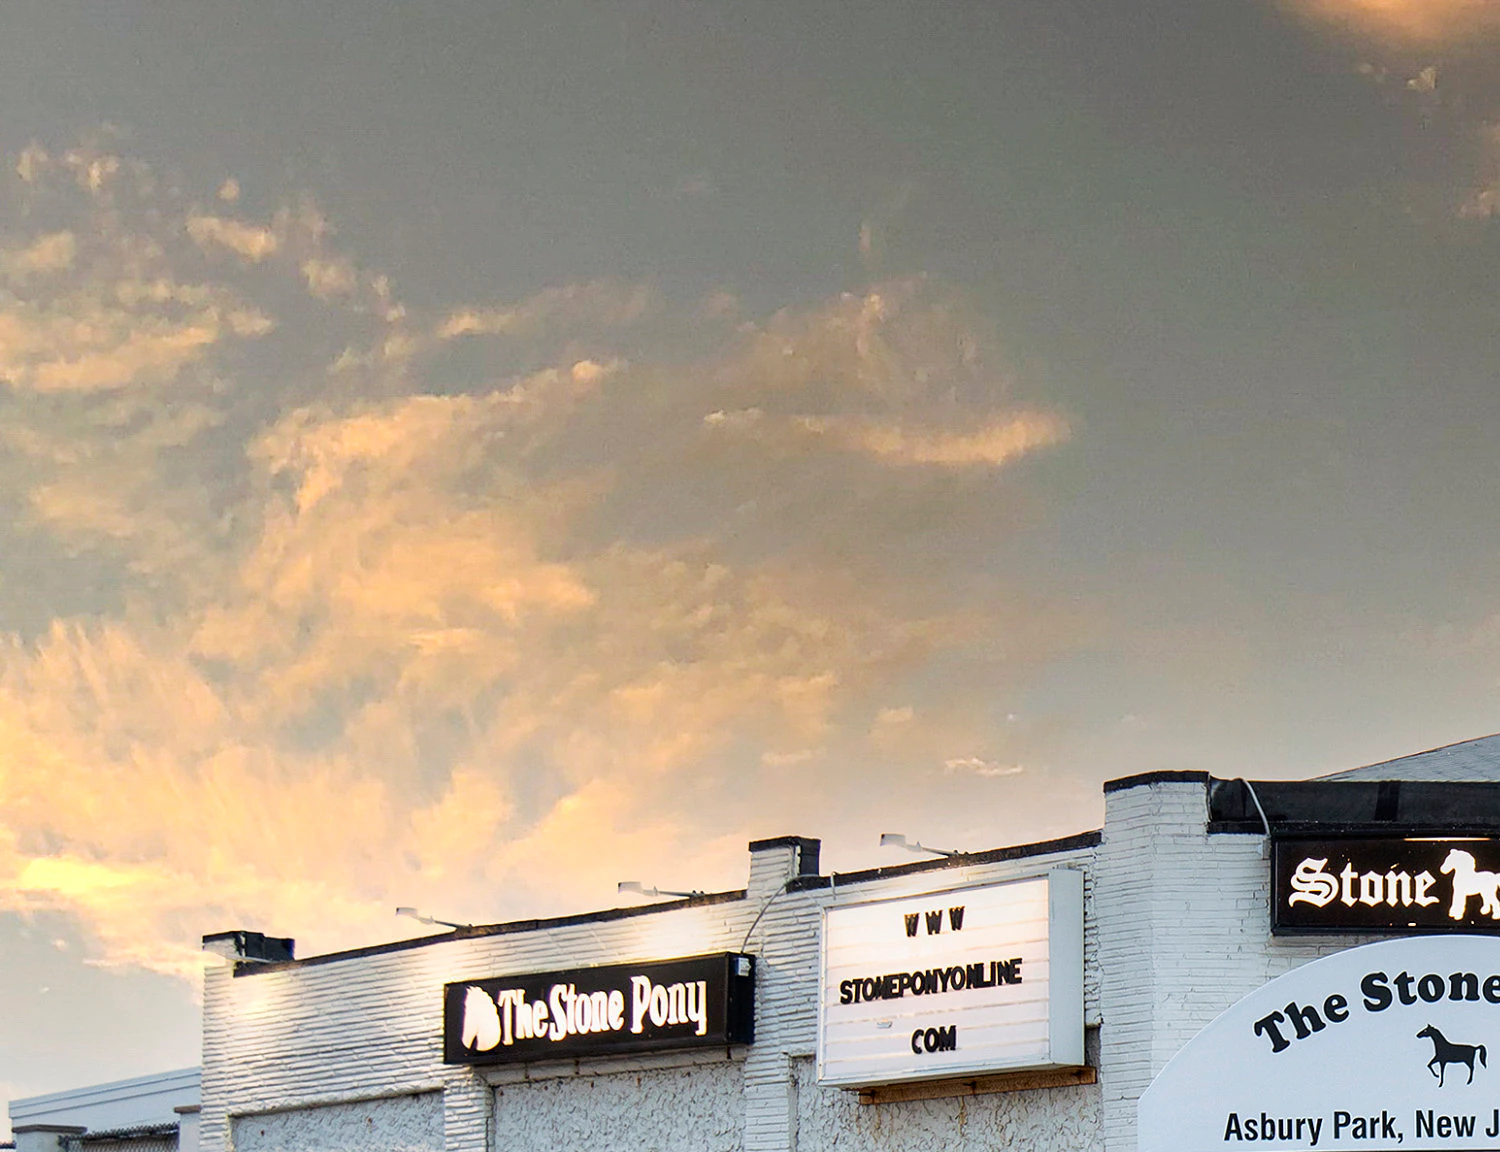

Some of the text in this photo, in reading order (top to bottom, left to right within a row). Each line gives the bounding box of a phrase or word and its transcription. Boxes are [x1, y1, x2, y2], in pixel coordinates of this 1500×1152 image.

[1288, 856, 1440, 908] Stone
[839, 958, 1023, 1004] STONEPONYONLINE
[498, 974, 708, 1045] The Stone Pony
[1253, 993, 1350, 1053] The
[911, 1025, 957, 1054] COM
[1224, 1112, 1322, 1146] Asbury
[1333, 1110, 1404, 1144] Park,
[1415, 1109, 1477, 1139] New
